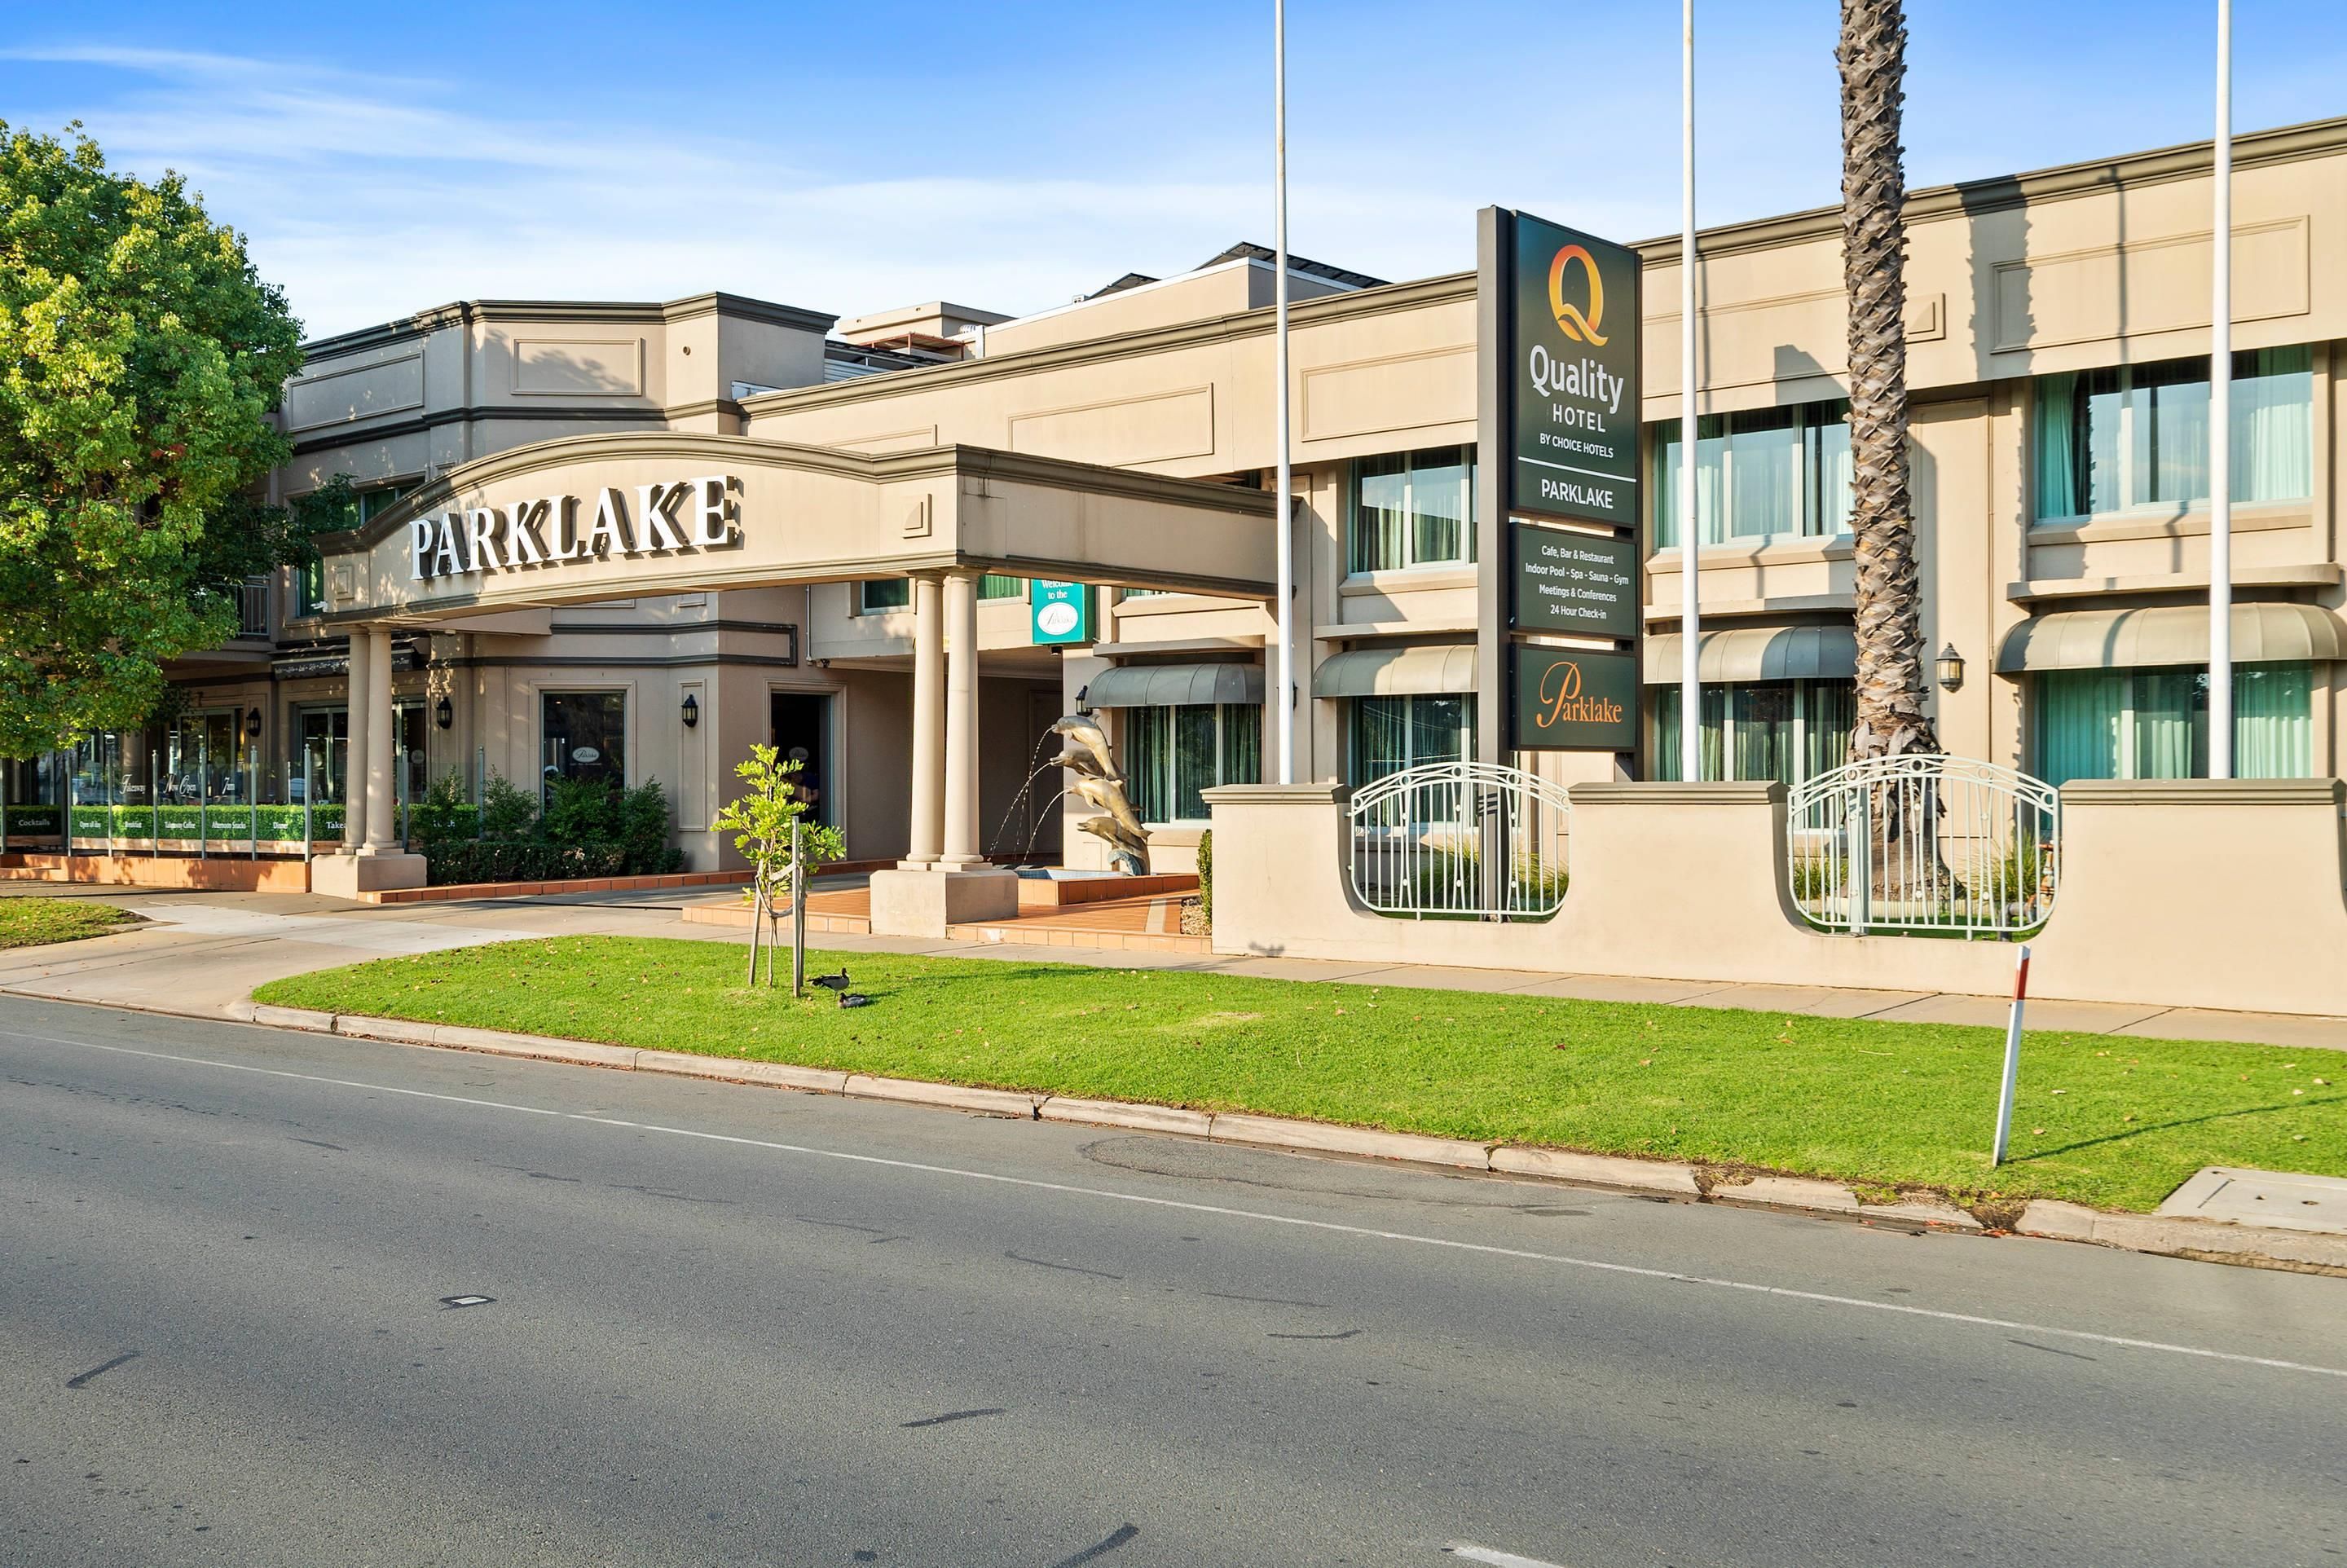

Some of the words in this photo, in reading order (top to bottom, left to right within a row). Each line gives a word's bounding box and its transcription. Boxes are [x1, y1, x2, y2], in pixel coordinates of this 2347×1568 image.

[1530, 345, 1623, 414] Quality
[1552, 403, 1606, 433] HOTEL
[1539, 433, 1552, 446] BY
[1552, 435, 1583, 452] CHOICE
[1583, 442, 1614, 459] HOTELS
[1541, 478, 1614, 509] PARKLAKE
[408, 475, 730, 581] PARKLAKE
[1541, 545, 1560, 559] Cafe,
[1560, 548, 1573, 559] Bar
[1573, 549, 1579, 560] &
[1579, 550, 1614, 565] Restaurant
[1525, 562, 1548, 575] Indoor
[1549, 566, 1565, 577] Pool
[1570, 568, 1583, 580] Spa
[1588, 570, 1609, 582] Sauna
[1614, 574, 1629, 586] Gym
[1056, 589, 1068, 598] the
[1539, 584, 1570, 598] Meetings
[1570, 588, 1576, 597] &
[1577, 588, 1617, 602] Conferences
[1550, 604, 1560, 614] 24
[1561, 606, 1578, 616] Hour
[1578, 607, 1607, 619] Check-in
[1535, 661, 1623, 728] Parklake
[18, 818, 51, 826] Cocktails
